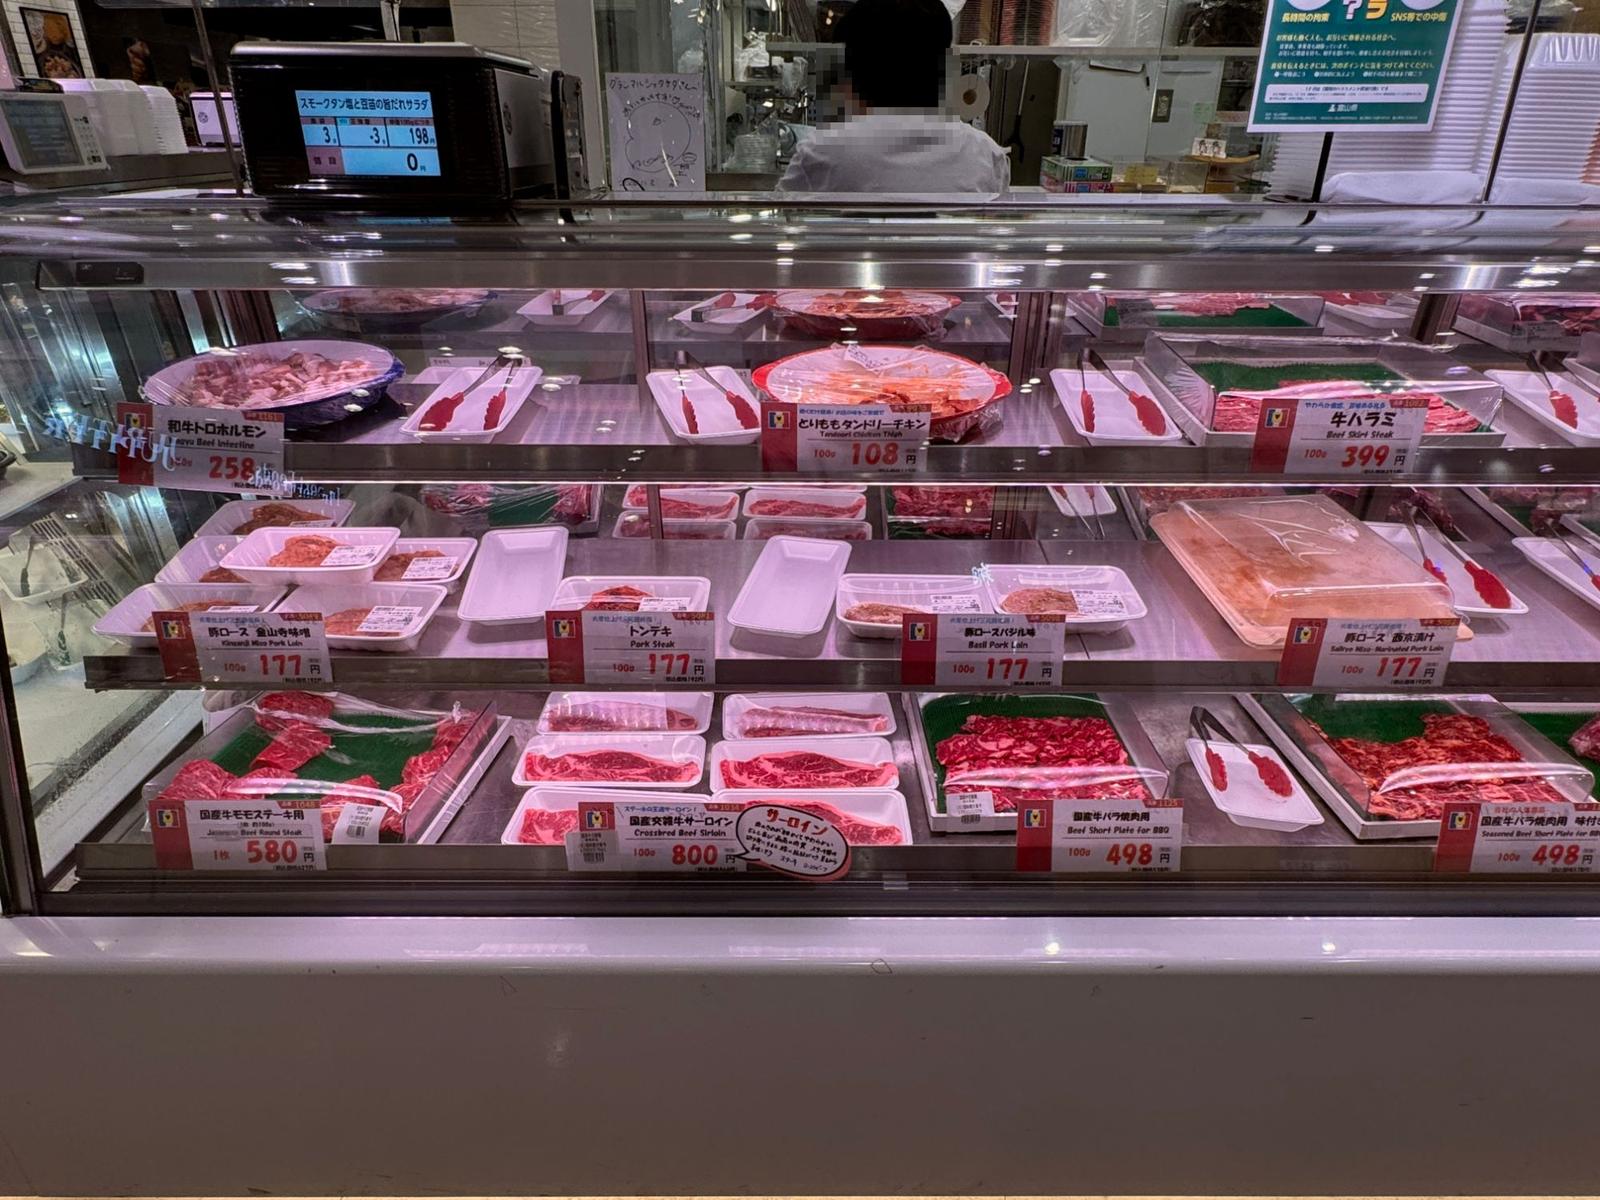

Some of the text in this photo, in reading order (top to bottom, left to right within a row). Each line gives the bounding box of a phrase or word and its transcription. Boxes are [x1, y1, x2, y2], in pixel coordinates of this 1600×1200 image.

[301, 98, 428, 110] スモークタン塩と豆苗の旨だれサラダ
[323, 126, 331, 143] 3
[410, 128, 429, 144] 198
[407, 153, 418, 172] 0
[799, 418, 926, 431] とりももタンドリーチキン
[1331, 412, 1397, 427] 牛ハラミ
[167, 419, 266, 438] 和牛トロホルモン
[883, 431, 903, 439] Thigh
[1326, 431, 1394, 439] Beef Skirt Steak
[165, 437, 255, 449] agyu Beef Intestine
[852, 442, 899, 465] 108
[1341, 445, 1389, 467] 399
[905, 455, 917, 465] 円
[1394, 455, 1405, 465] 円
[208, 455, 256, 480] 258
[208, 627, 311, 638] 豚ロース 金山寺味噌
[630, 626, 672, 637] トンテキ
[964, 628, 1036, 638] 豚ロースバジル味
[1344, 633, 1435, 643] 豚ロース 西京漬け
[653, 640, 675, 648] Steak
[989, 641, 1009, 649] Pork
[1011, 641, 1028, 649] Loin
[260, 654, 302, 676] 177
[310, 664, 321, 674] 円
[648, 653, 691, 675] 177
[987, 658, 1029, 680] 177
[1376, 657, 1422, 677] 177
[694, 665, 704, 675] 円
[1041, 668, 1051, 678] 円
[1424, 668, 1435, 677] 円
[200, 810, 304, 820] 国産牛モモステーキ用
[1073, 812, 1150, 822] 国産牛バラ焼肉用
[629, 816, 733, 826] 国産交雑牛サーロイン
[767, 808, 828, 836] サーロイン
[1481, 816, 1567, 826] 国産牛バラ焼肉用
[634, 829, 726, 837] Crossbred Beef Sirloin
[1067, 826, 1169, 834] Beef Short Plate for BBQ
[247, 840, 297, 864] 580
[304, 852, 315, 862] 円
[672, 844, 718, 865] 800
[1106, 843, 1153, 865] 498
[1532, 844, 1580, 865] 498
[1160, 853, 1170, 863] 円
[1582, 855, 1593, 864] 円
